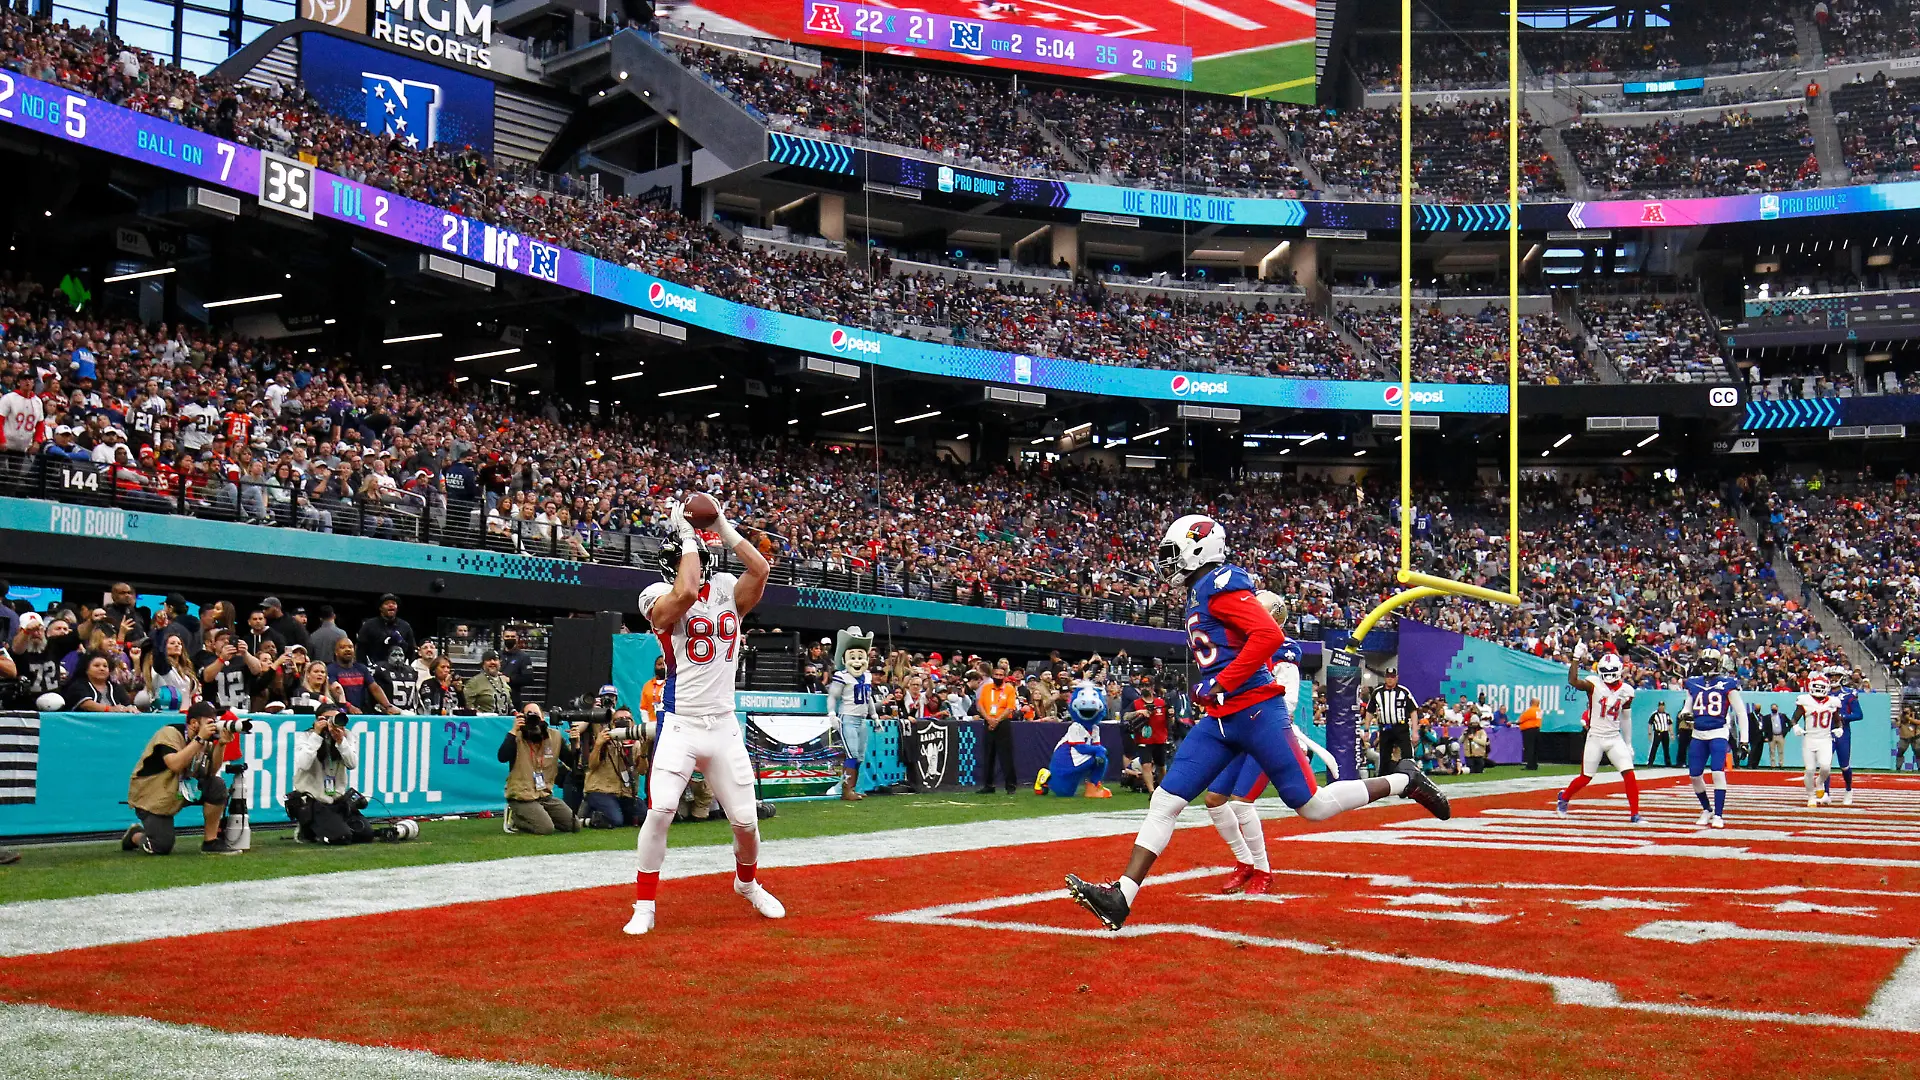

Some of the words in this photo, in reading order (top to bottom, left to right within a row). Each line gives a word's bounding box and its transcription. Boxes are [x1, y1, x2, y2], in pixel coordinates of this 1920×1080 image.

[856, 9, 882, 33] 22
[909, 16, 934, 39] 21
[375, 18, 491, 69] RESORTS
[991, 39, 1009, 51] QTR
[1011, 34, 1022, 53] 2
[1036, 37, 1075, 59] 5:04
[1096, 45, 1117, 64] 35
[1132, 49, 1143, 68] 2
[1435, 93, 1461, 104] 406
[21, 92, 45, 121] ND
[48, 102, 61, 125] &
[65, 95, 87, 139] 5
[138, 130, 176, 158] BALL
[182, 144, 202, 166] ON
[217, 142, 236, 182] 7
[268, 161, 307, 209] 35
[954, 173, 972, 192] PRO
[974, 177, 999, 196] BOWL
[331, 180, 366, 222] TOL
[374, 196, 389, 228] 2
[1123, 190, 1145, 214] WE
[1151, 194, 1178, 217] RUN
[1184, 198, 1201, 220] AS
[1208, 200, 1235, 222] ONE
[1782, 199, 1803, 214] PRO
[1807, 195, 1838, 212] BOWL
[121, 231, 138, 244] 101
[442, 214, 469, 256] 21
[483, 225, 519, 270] NFC
[665, 292, 698, 313] pepsi
[847, 337, 881, 354] pepsi
[1190, 380, 1229, 395] pepsi
[1712, 391, 1735, 404] CC
[15, 412, 36, 432] 98
[135, 411, 155, 434] 21
[232, 421, 246, 436] 21
[1713, 441, 1728, 450] 106
[1741, 441, 1756, 449] 107
[62, 468, 99, 492] 144
[50, 504, 81, 534] PRO
[84, 508, 128, 540] BOWL
[128, 513, 139, 529] 22
[686, 610, 739, 666] 89
[29, 661, 59, 693] 72
[215, 671, 246, 709] 12
[393, 680, 416, 708] 57
[1514, 684, 1565, 715] BOWL
[1564, 685, 1578, 702] 22
[1693, 691, 1723, 717] 48
[1600, 697, 1622, 721] 14
[1810, 710, 1832, 730] 10
[920, 730, 944, 743] RAIDERS
[243, 720, 296, 810] RO
[350, 720, 442, 804] OWL
[442, 721, 471, 765] 22
